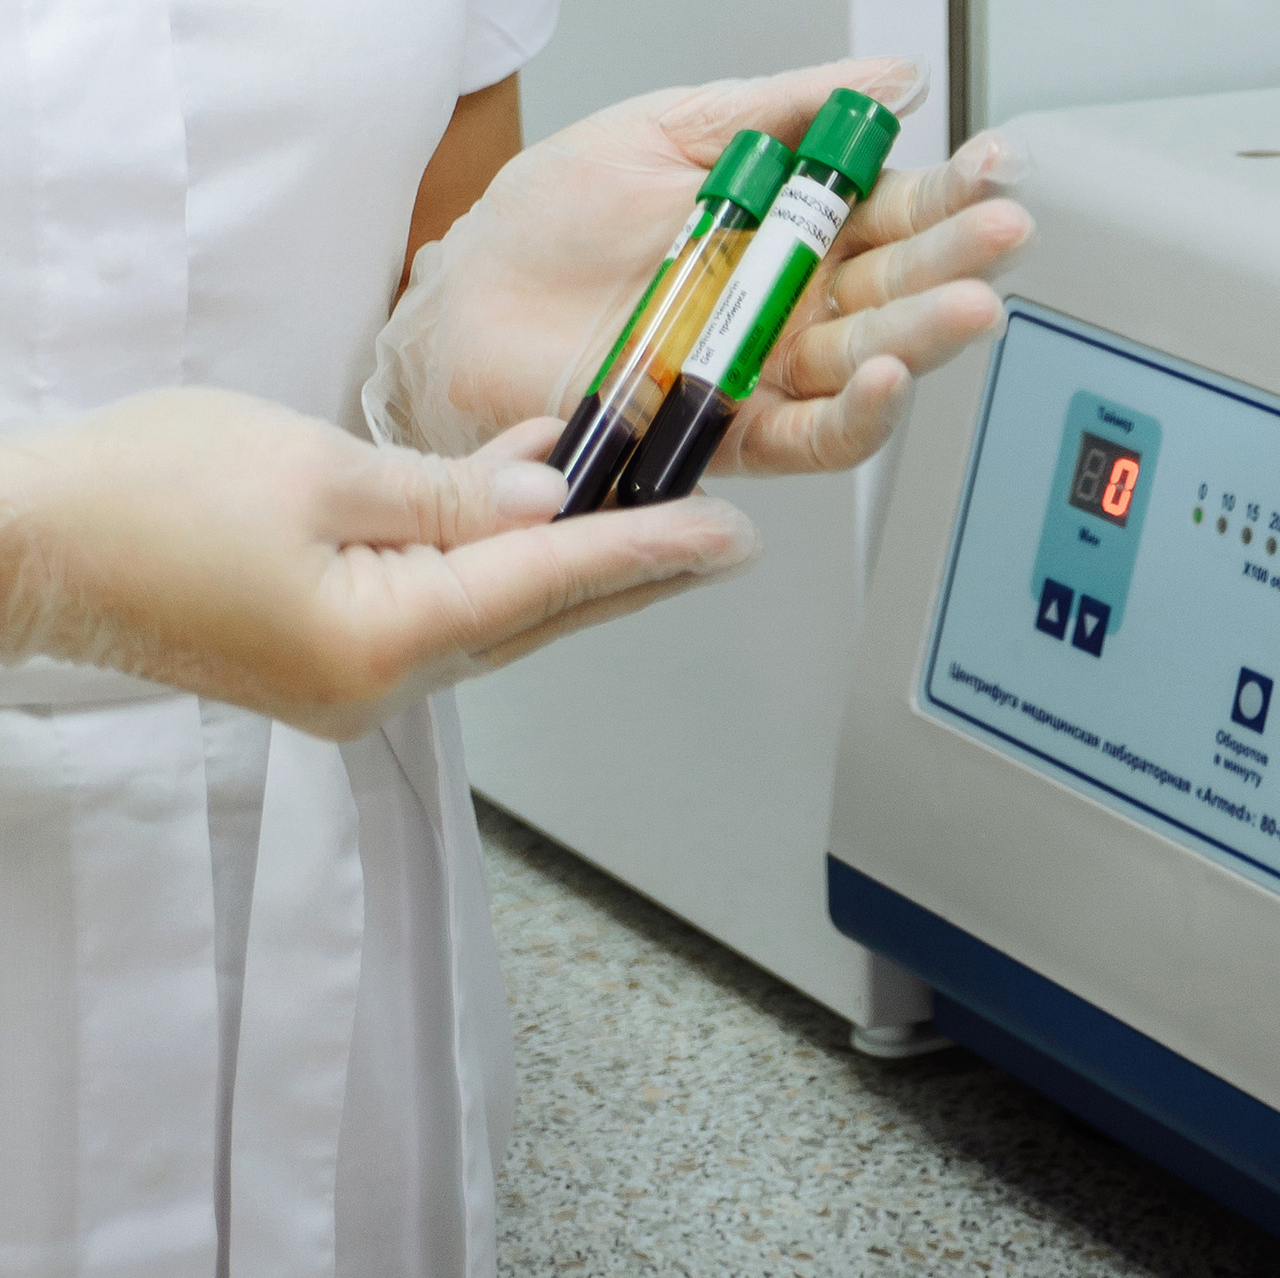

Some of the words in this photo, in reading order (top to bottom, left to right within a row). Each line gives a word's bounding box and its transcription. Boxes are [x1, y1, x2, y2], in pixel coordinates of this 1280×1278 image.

[700, 346, 715, 365] Gel
[1101, 457, 1140, 517] 0
[1222, 493, 1236, 512] 10
[1246, 503, 1260, 522] 15
[1021, 698, 1101, 748] медицинская
[1101, 741, 1192, 794] лабораторная
